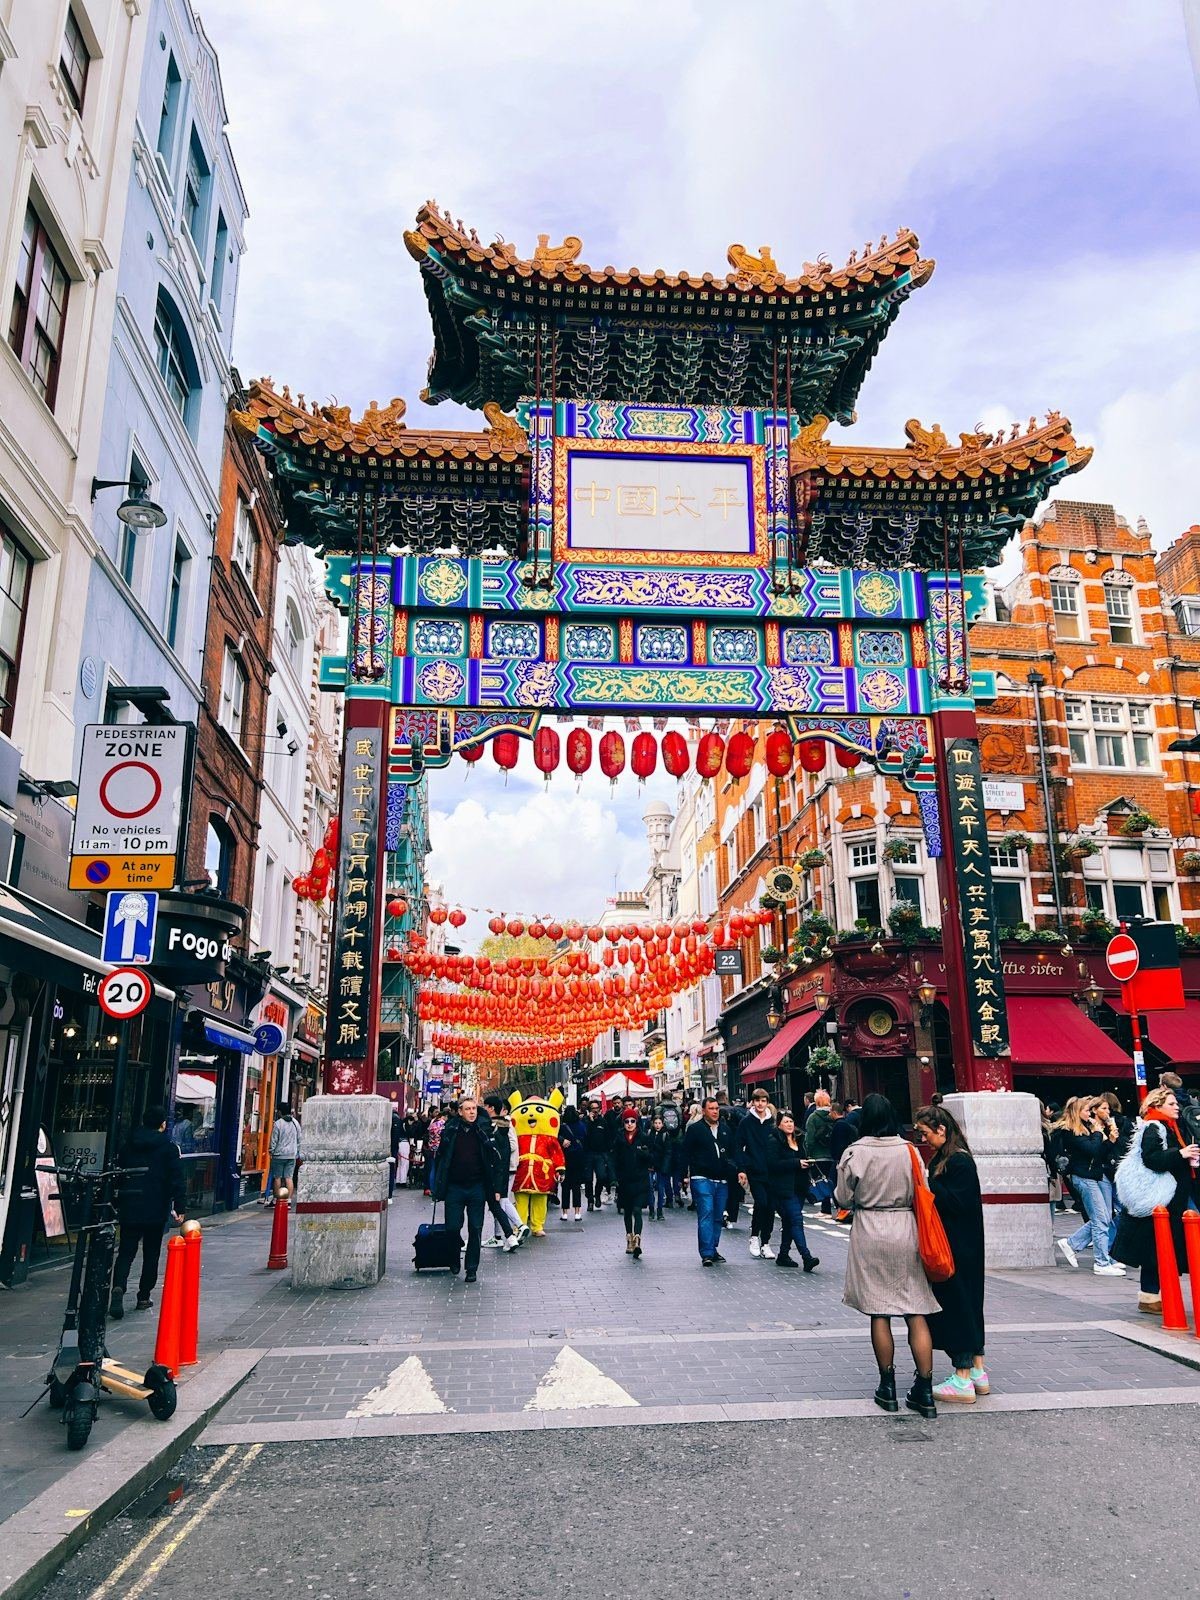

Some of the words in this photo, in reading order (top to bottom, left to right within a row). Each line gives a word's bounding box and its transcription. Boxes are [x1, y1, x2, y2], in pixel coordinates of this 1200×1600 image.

[574, 480, 745, 521] 中國太平
[95, 730, 176, 739] PEDESTRIAN
[105, 743, 163, 757] ZONE
[985, 789, 1005, 797] STREET
[92, 825, 109, 835] No
[113, 825, 161, 835] vehicles
[79, 839, 90, 849] 11
[92, 841, 110, 849] am
[123, 837, 141, 850] 10
[145, 839, 169, 851] pm
[121, 861, 136, 870] At
[139, 863, 161, 872] any
[127, 873, 153, 883] time
[168, 927, 218, 960] Fogo
[721, 955, 736, 966] 22
[1029, 962, 1064, 976] sister
[82, 972, 96, 994] Tel:
[107, 982, 143, 1003] 20
[223, 980, 236, 1013] 97
[63, 1145, 91, 1156] Fogo
